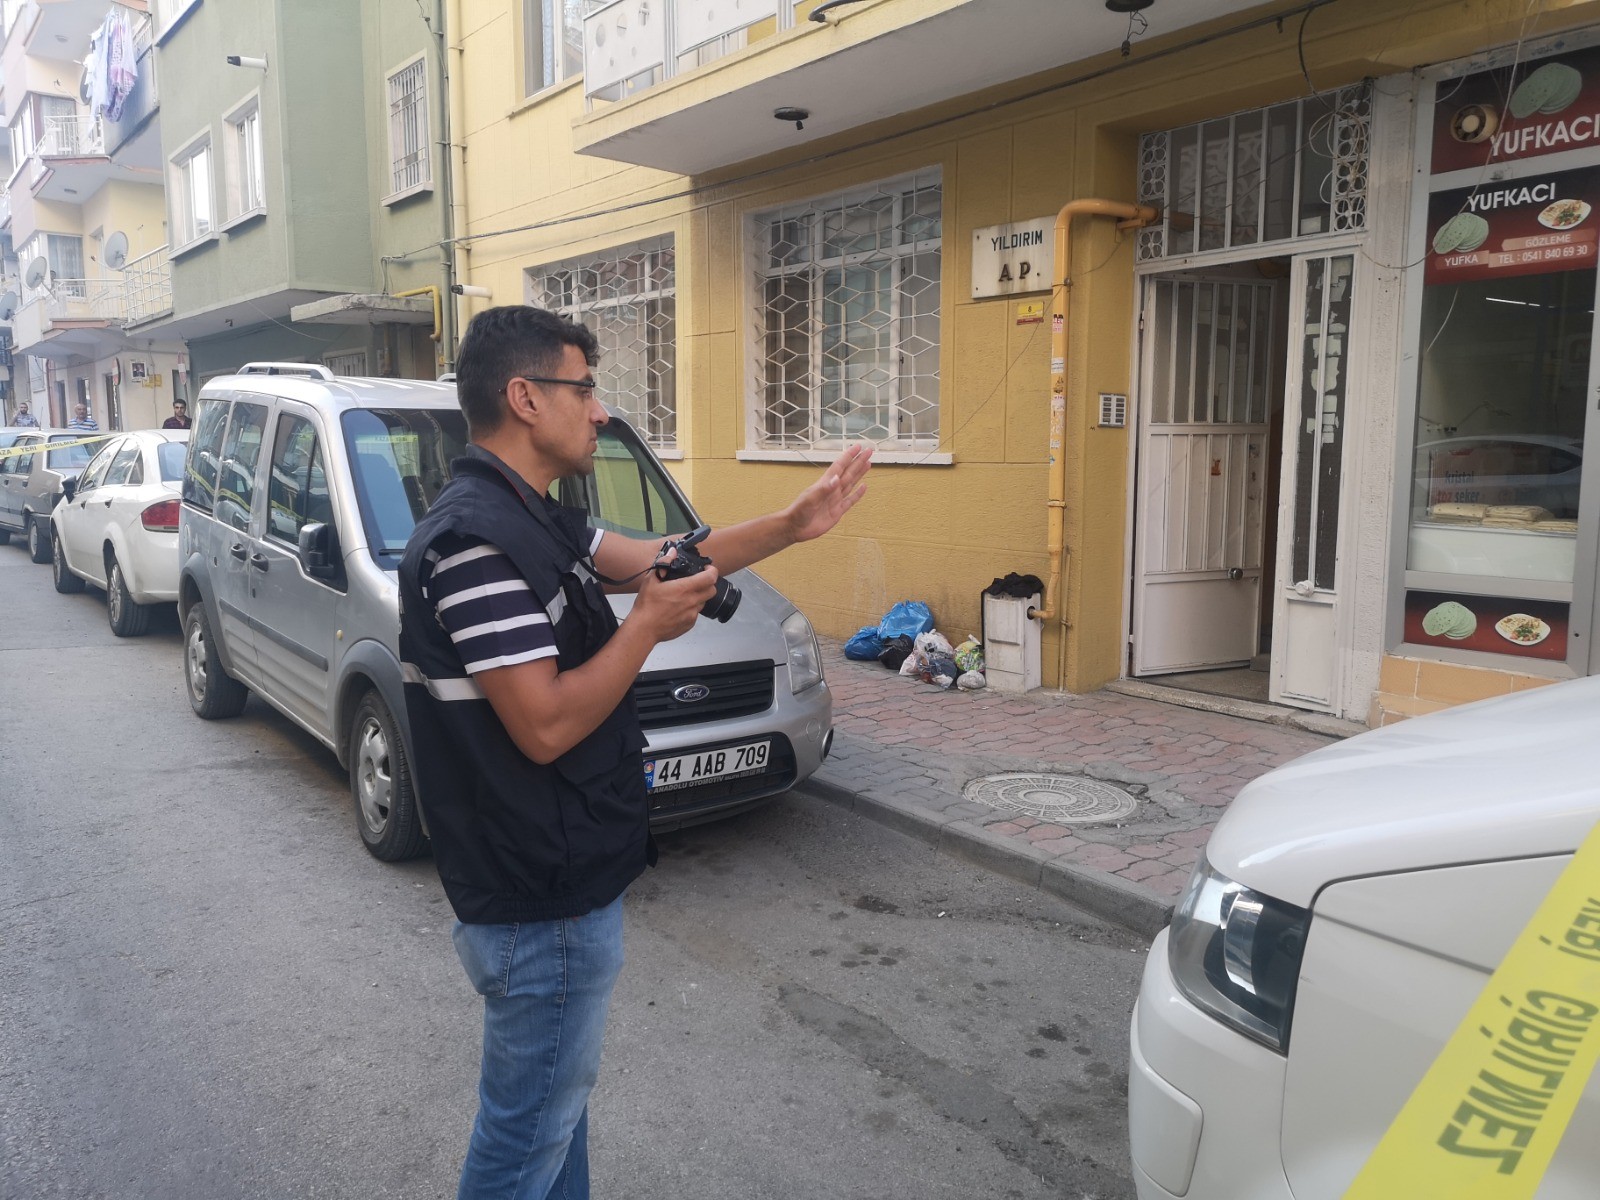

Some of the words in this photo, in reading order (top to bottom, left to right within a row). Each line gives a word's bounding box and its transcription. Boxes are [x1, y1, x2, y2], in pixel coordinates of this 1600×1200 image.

[1490, 113, 1600, 157] YUFKACI
[1467, 182, 1556, 212] YUFKACI
[991, 229, 1043, 252] YILDIRIM
[1525, 233, 1571, 247] GÖZLEME
[1444, 254, 1479, 267] YUFKA
[1498, 254, 1515, 265] TEL
[1522, 250, 1542, 262] 0541
[1544, 248, 1562, 259] 840
[1562, 246, 1575, 257] 69
[683, 687, 702, 698] Ford
[658, 759, 682, 783] 44
[691, 752, 726, 778] AAB
[734, 744, 767, 770] 709
